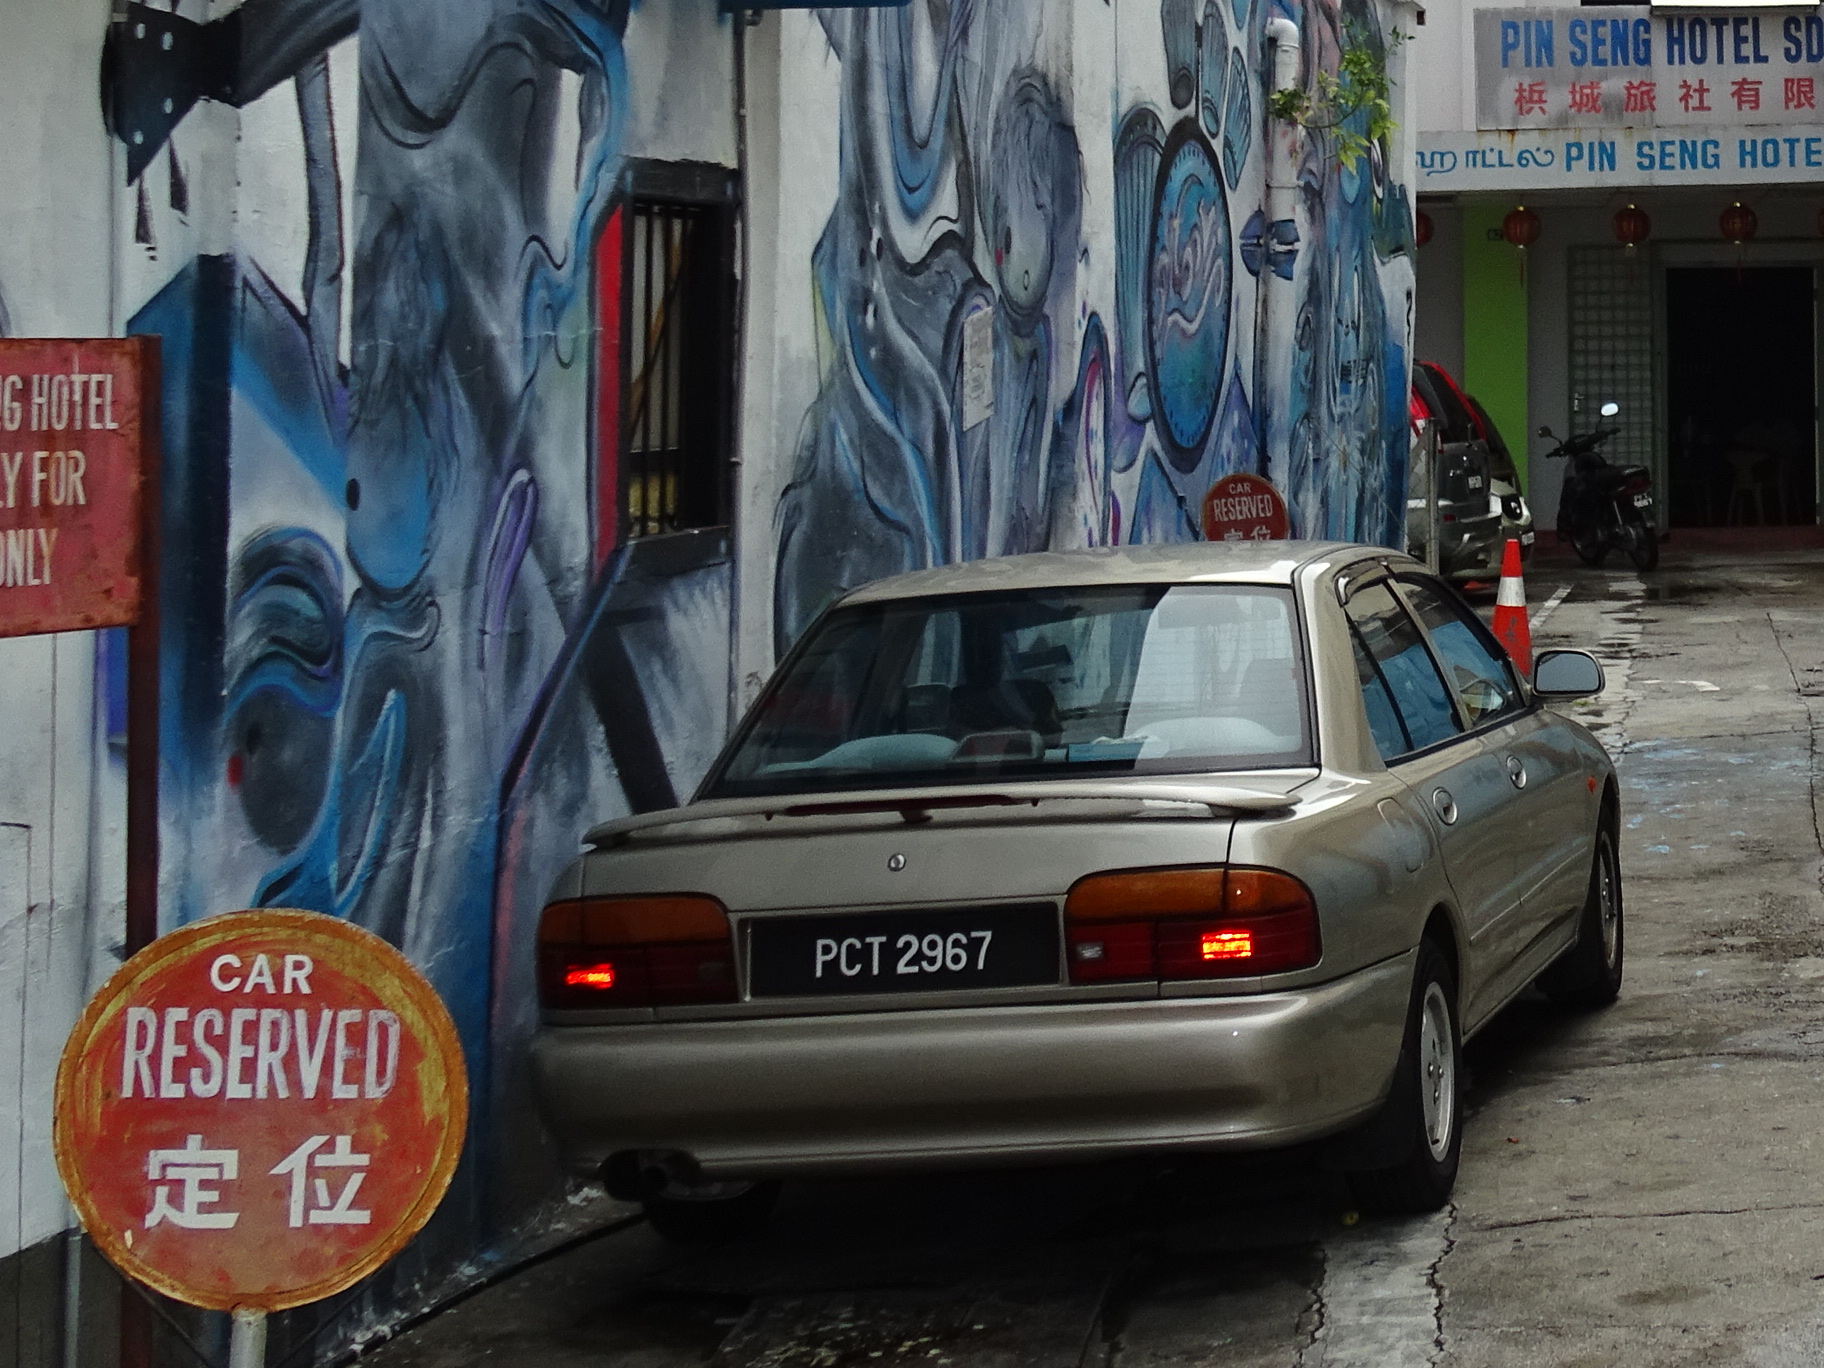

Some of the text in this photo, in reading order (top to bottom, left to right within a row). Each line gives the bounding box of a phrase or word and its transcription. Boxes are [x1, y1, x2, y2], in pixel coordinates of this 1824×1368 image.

[1501, 20, 1555, 68] PIN
[1568, 19, 1652, 67] SENG
[1666, 16, 1769, 66] HOTEL
[1565, 140, 1617, 173] PIN
[1636, 139, 1721, 172] SENG
[31, 373, 119, 431] HOTEL
[31, 450, 86, 507] FOR
[1229, 482, 1251, 494] CAR
[1214, 495, 1273, 521] RESERVED
[209, 954, 314, 995] CAR
[815, 931, 993, 978] PCT 2967
[121, 1006, 401, 1099] RESERVED
[144, 1134, 372, 1229] 定位
